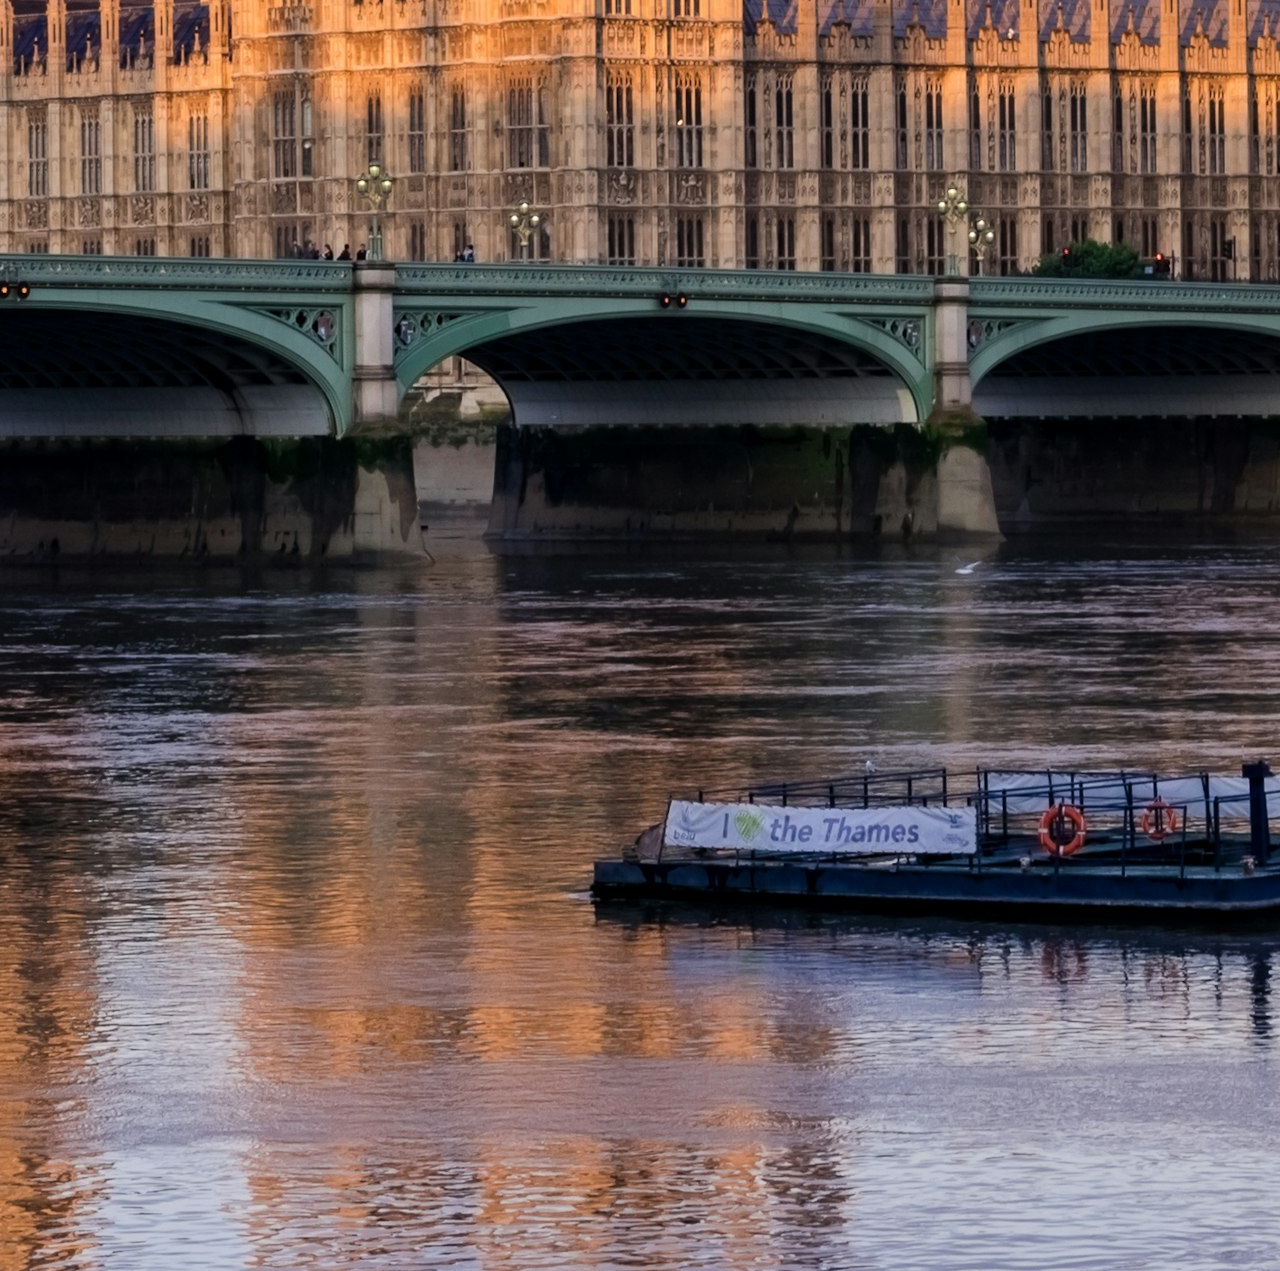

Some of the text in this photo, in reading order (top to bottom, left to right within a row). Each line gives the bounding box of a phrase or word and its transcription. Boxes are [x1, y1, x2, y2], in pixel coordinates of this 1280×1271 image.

[723, 813, 729, 839] I
[770, 816, 814, 843] the
[823, 817, 919, 844] Thames
